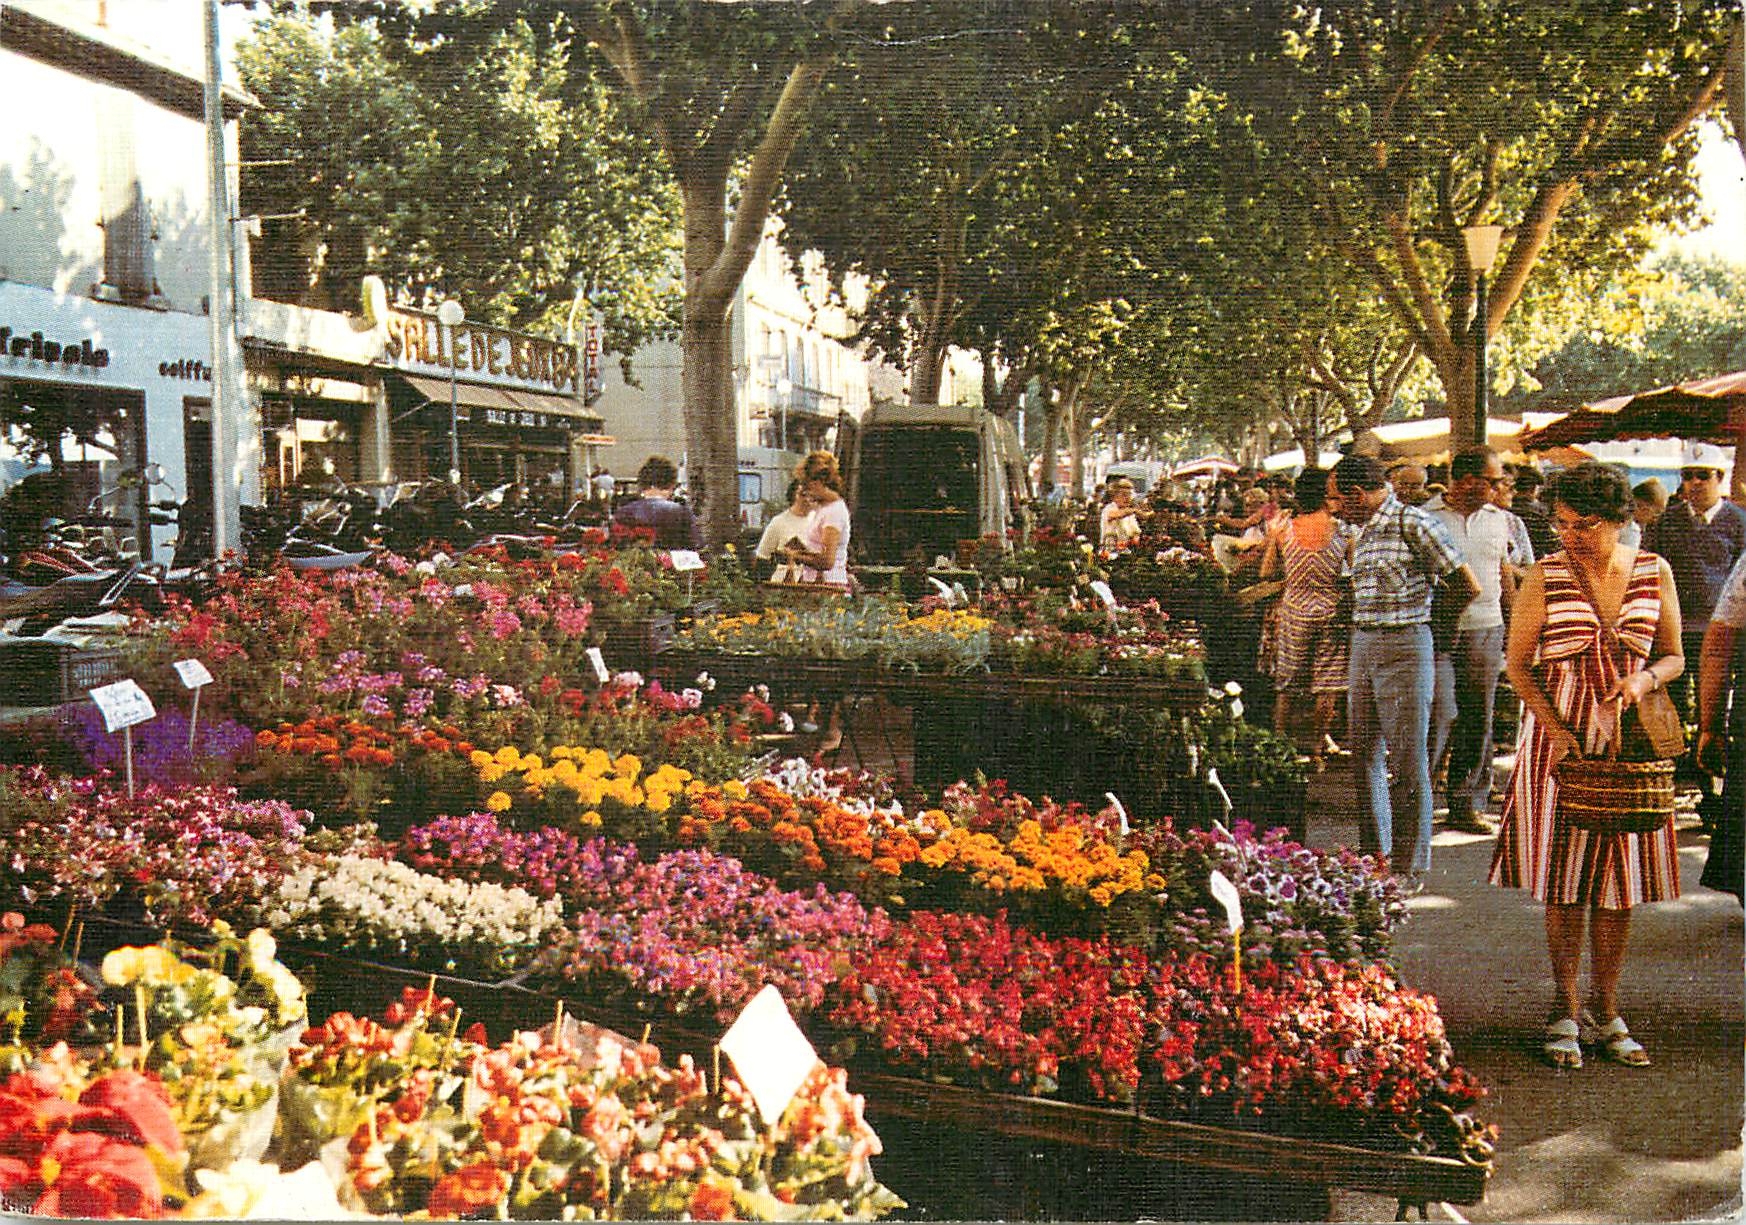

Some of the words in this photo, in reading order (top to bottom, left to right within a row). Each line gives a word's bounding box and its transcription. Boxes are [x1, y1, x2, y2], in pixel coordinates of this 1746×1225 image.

[384, 311, 469, 370] SALLE
[471, 330, 502, 376] DE
[159, 357, 212, 381] coiffu
